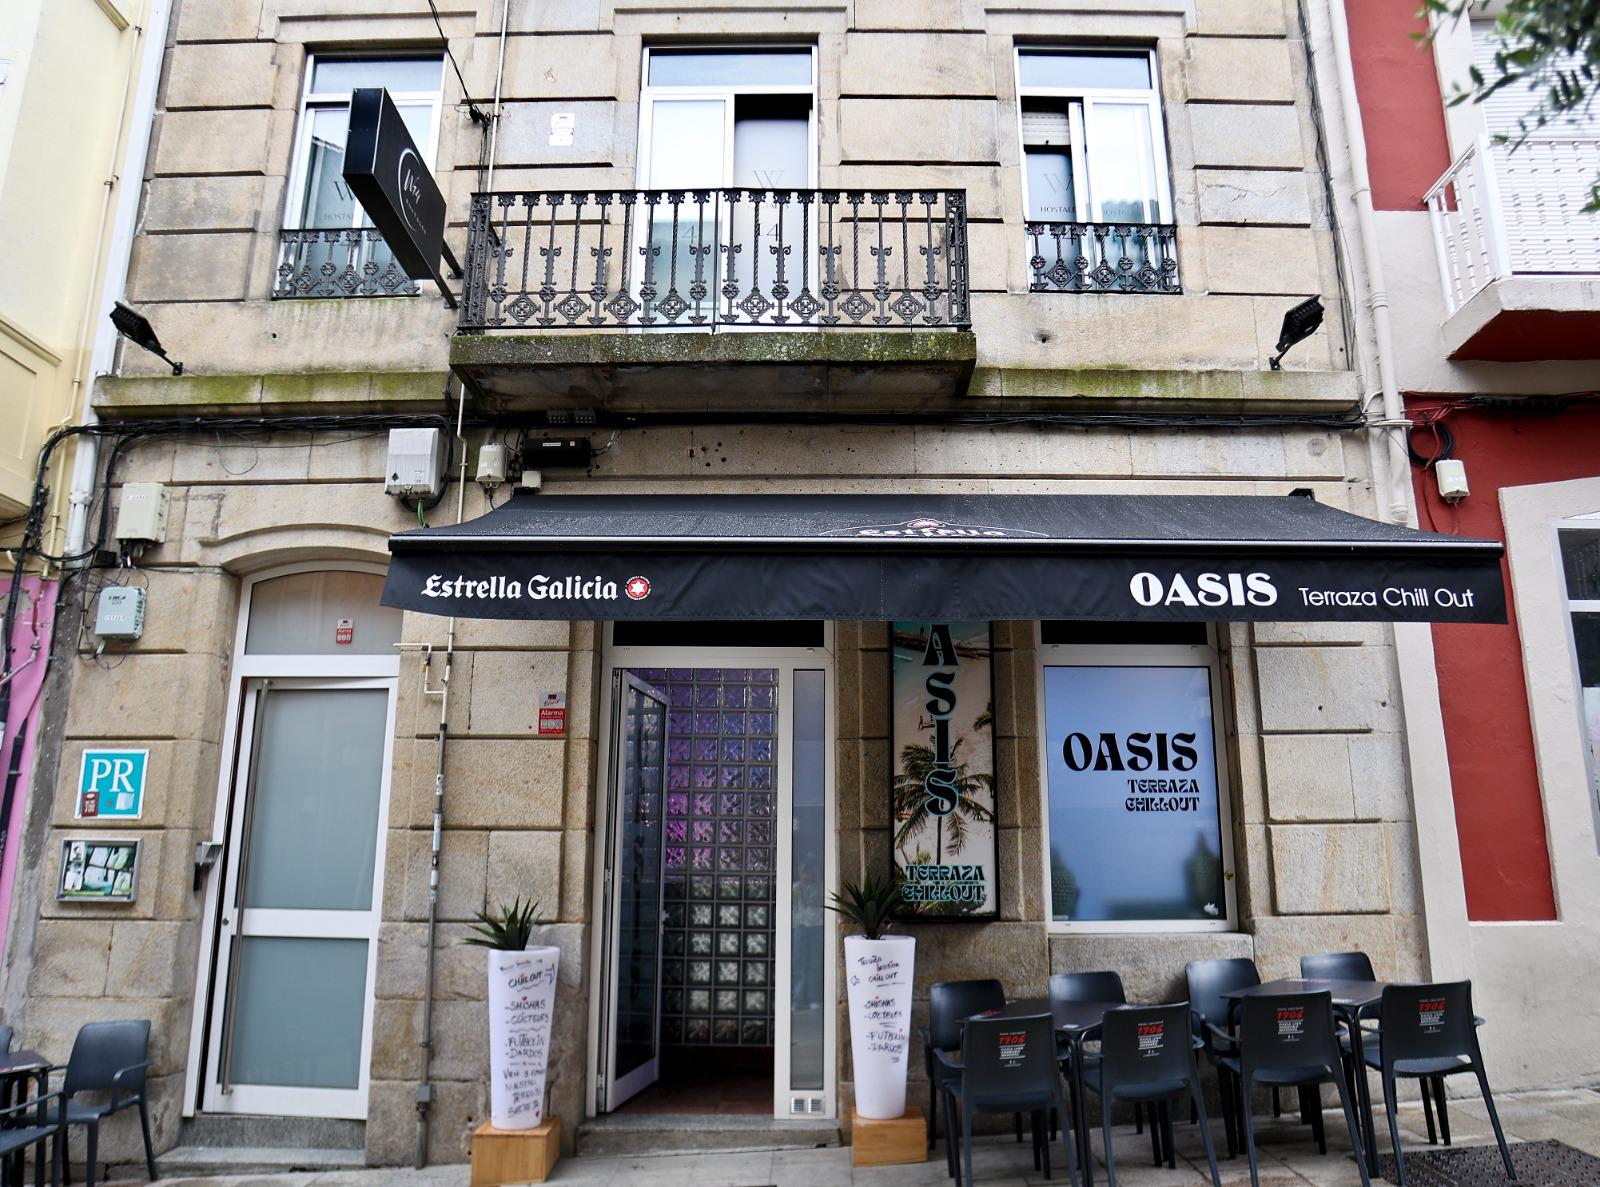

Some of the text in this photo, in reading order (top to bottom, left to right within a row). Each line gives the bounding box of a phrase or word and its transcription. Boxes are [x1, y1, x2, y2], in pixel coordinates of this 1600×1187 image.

[421, 574, 522, 599] Estrella
[527, 574, 618, 600] Galicia
[1129, 572, 1278, 607] OASIS
[1298, 587, 1474, 607] Terraza Chill Out
[921, 624, 960, 817] ASIS
[1062, 732, 1198, 772] OASIS
[87, 758, 135, 793] PR
[1127, 779, 1200, 794] TERRAZA
[1125, 797, 1200, 812] CHILLOUT
[904, 864, 985, 881] TERRAZA
[901, 884, 985, 901] CHILLOUT
[1276, 1008, 1304, 1021] 1906
[1136, 1023, 1164, 1036] 1906
